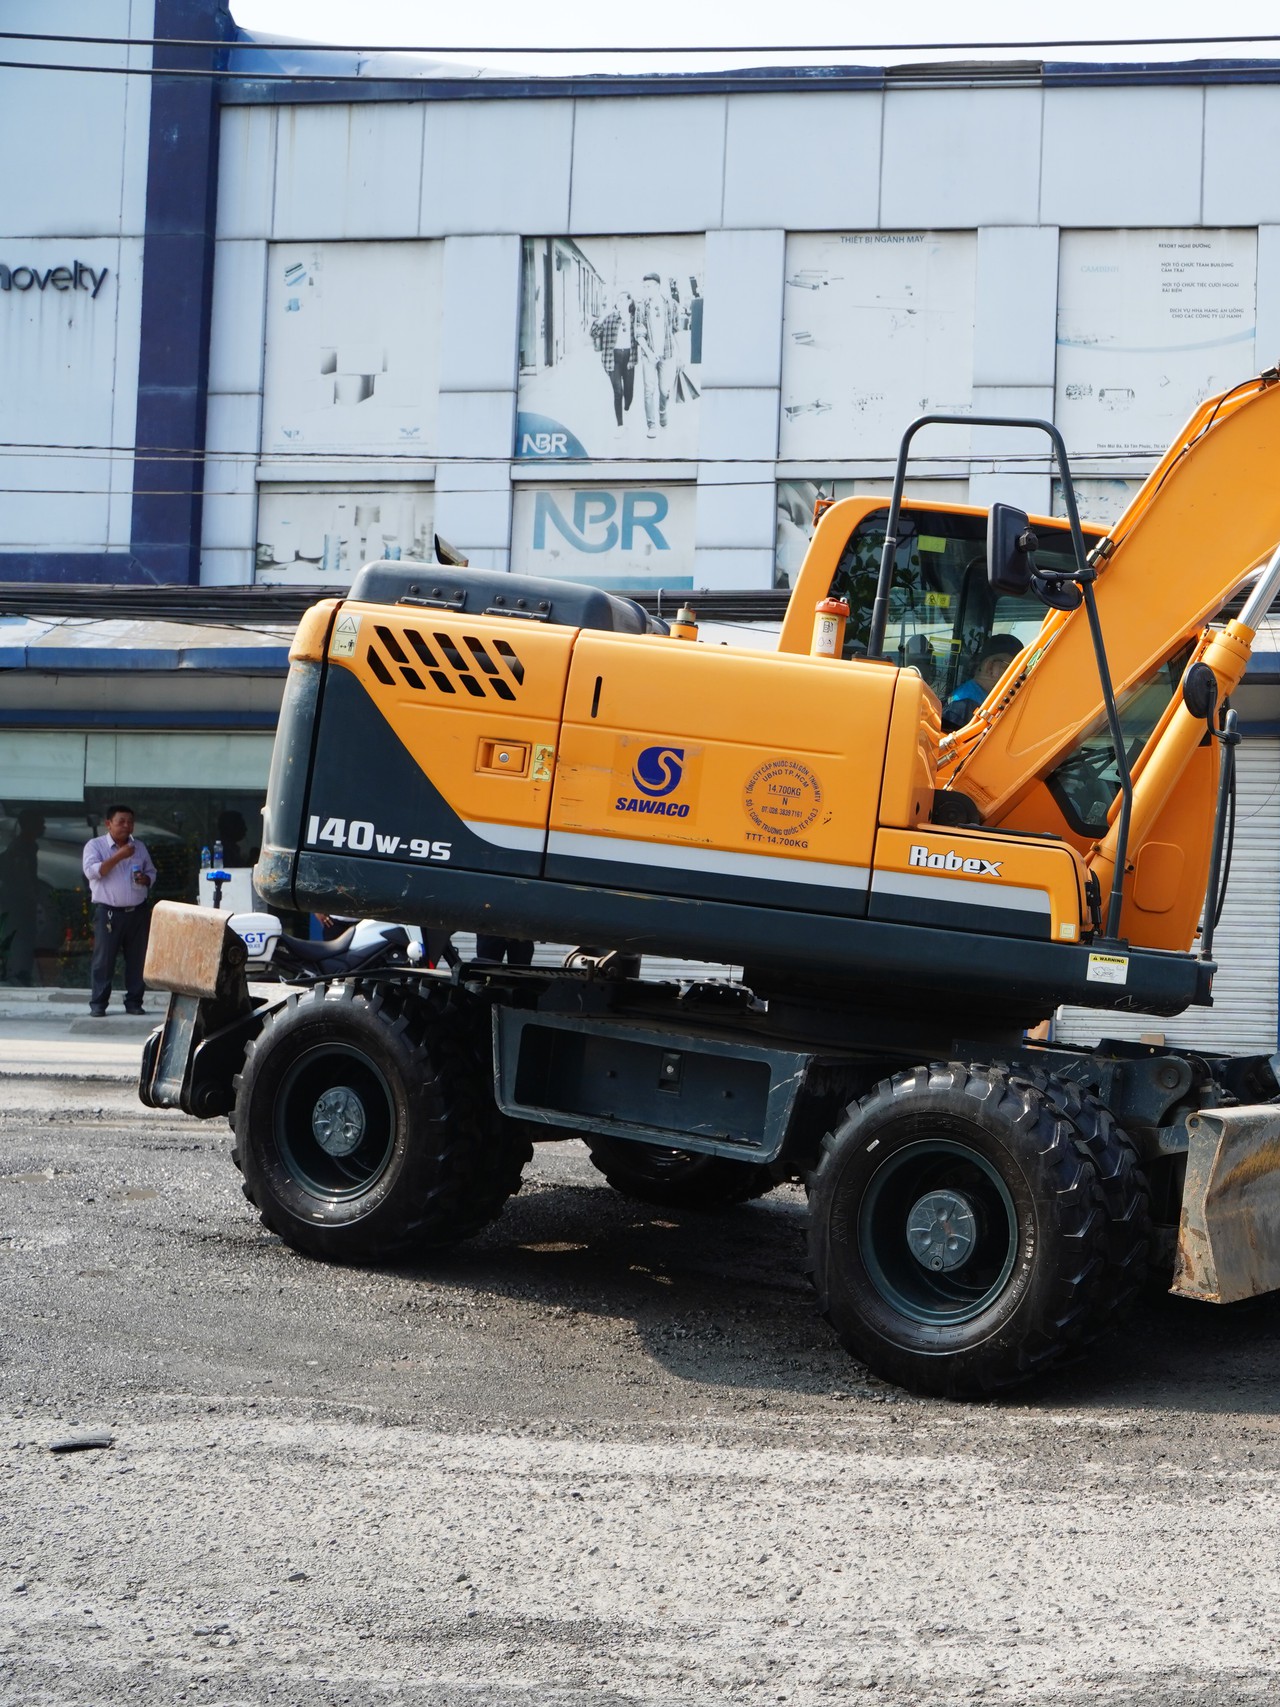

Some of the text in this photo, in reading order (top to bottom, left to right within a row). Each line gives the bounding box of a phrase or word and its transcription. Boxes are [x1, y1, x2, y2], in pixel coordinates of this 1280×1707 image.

[906, 235, 925, 244] MAY
[522, 433, 567, 454] NBR
[533, 491, 671, 554] NBR
[762, 769, 783, 783] UBND
[794, 773, 810, 788] HCM
[768, 784, 801, 796] 14.700KG
[615, 797, 690, 818] SAWACO
[782, 797, 788, 806] N
[767, 836, 808, 849] 14.700KG
[908, 844, 1004, 877] Robex
